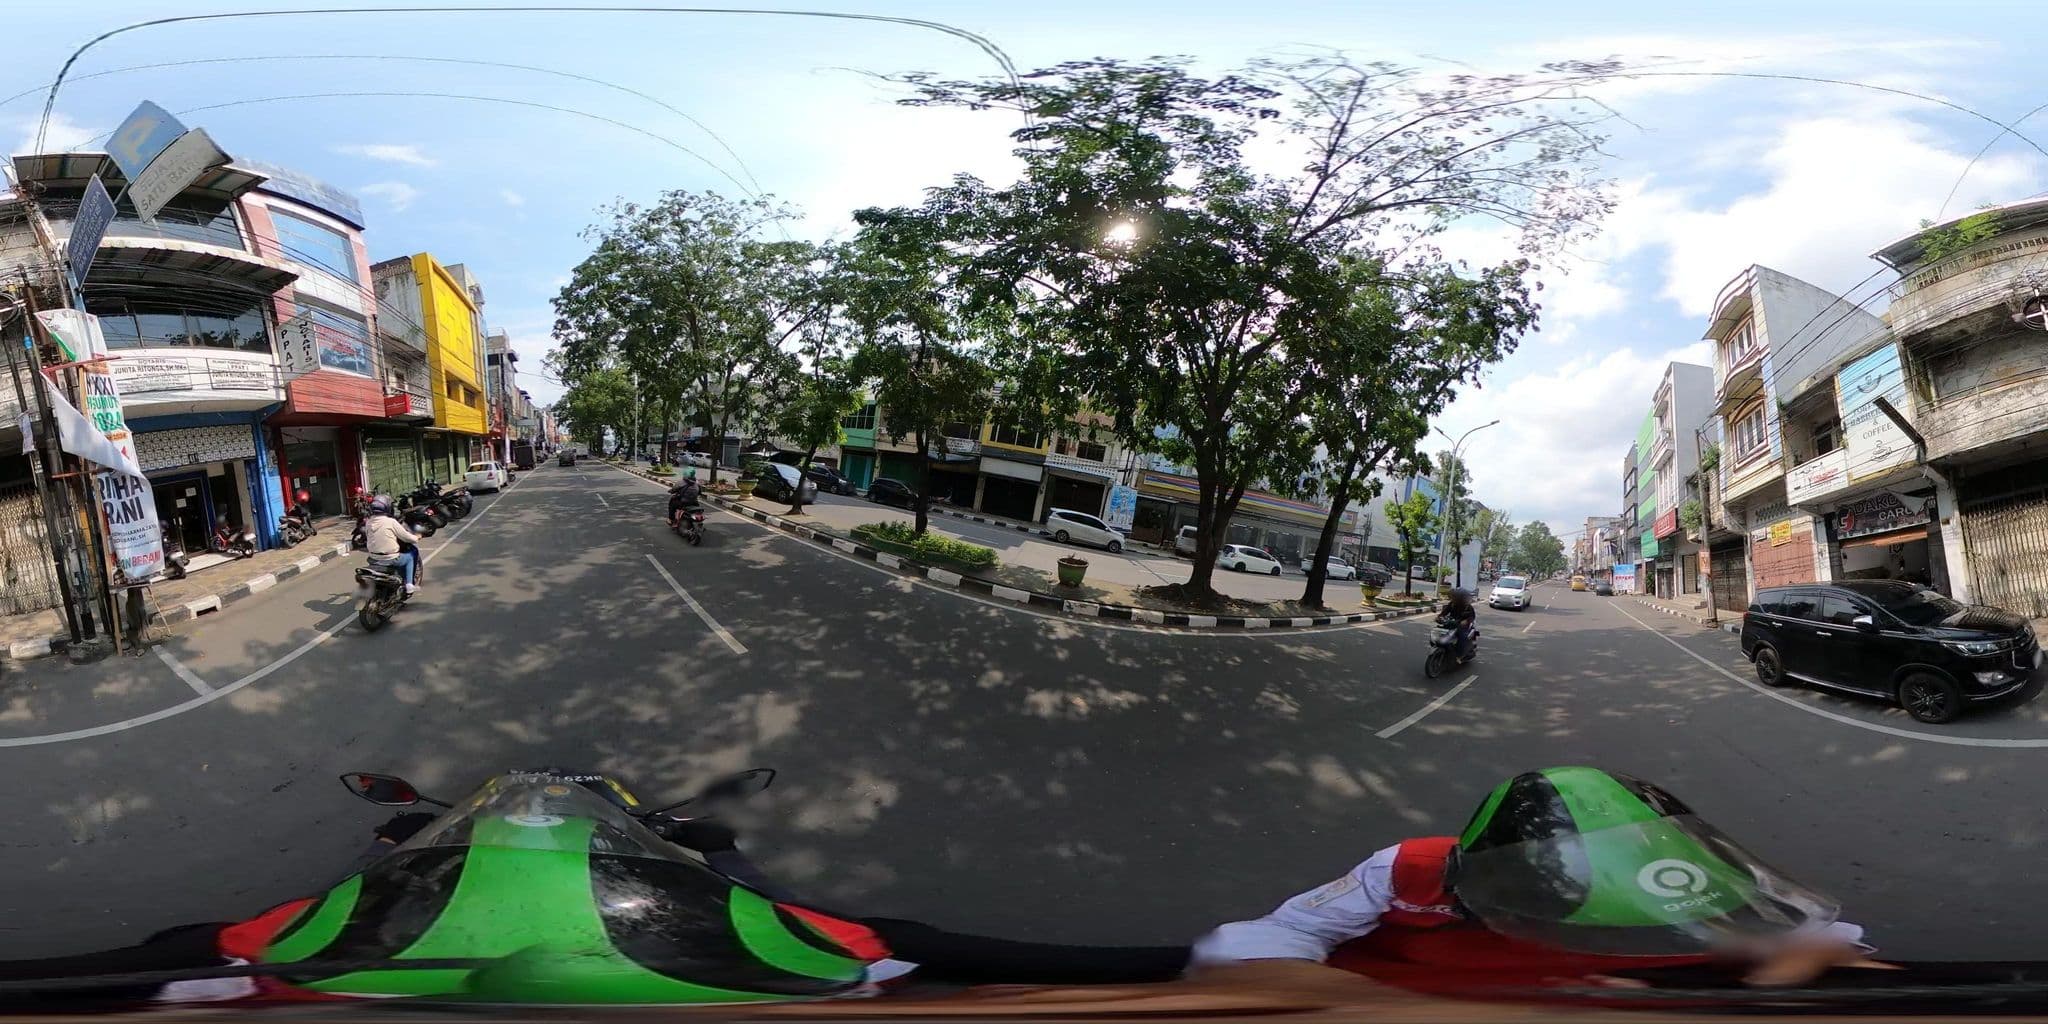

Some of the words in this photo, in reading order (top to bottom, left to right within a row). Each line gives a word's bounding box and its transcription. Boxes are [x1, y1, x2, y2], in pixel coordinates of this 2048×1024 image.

[281, 329, 294, 372] PPAT
[299, 321, 313, 363] NOTARIS
[1862, 422, 1893, 439] COFFEE
